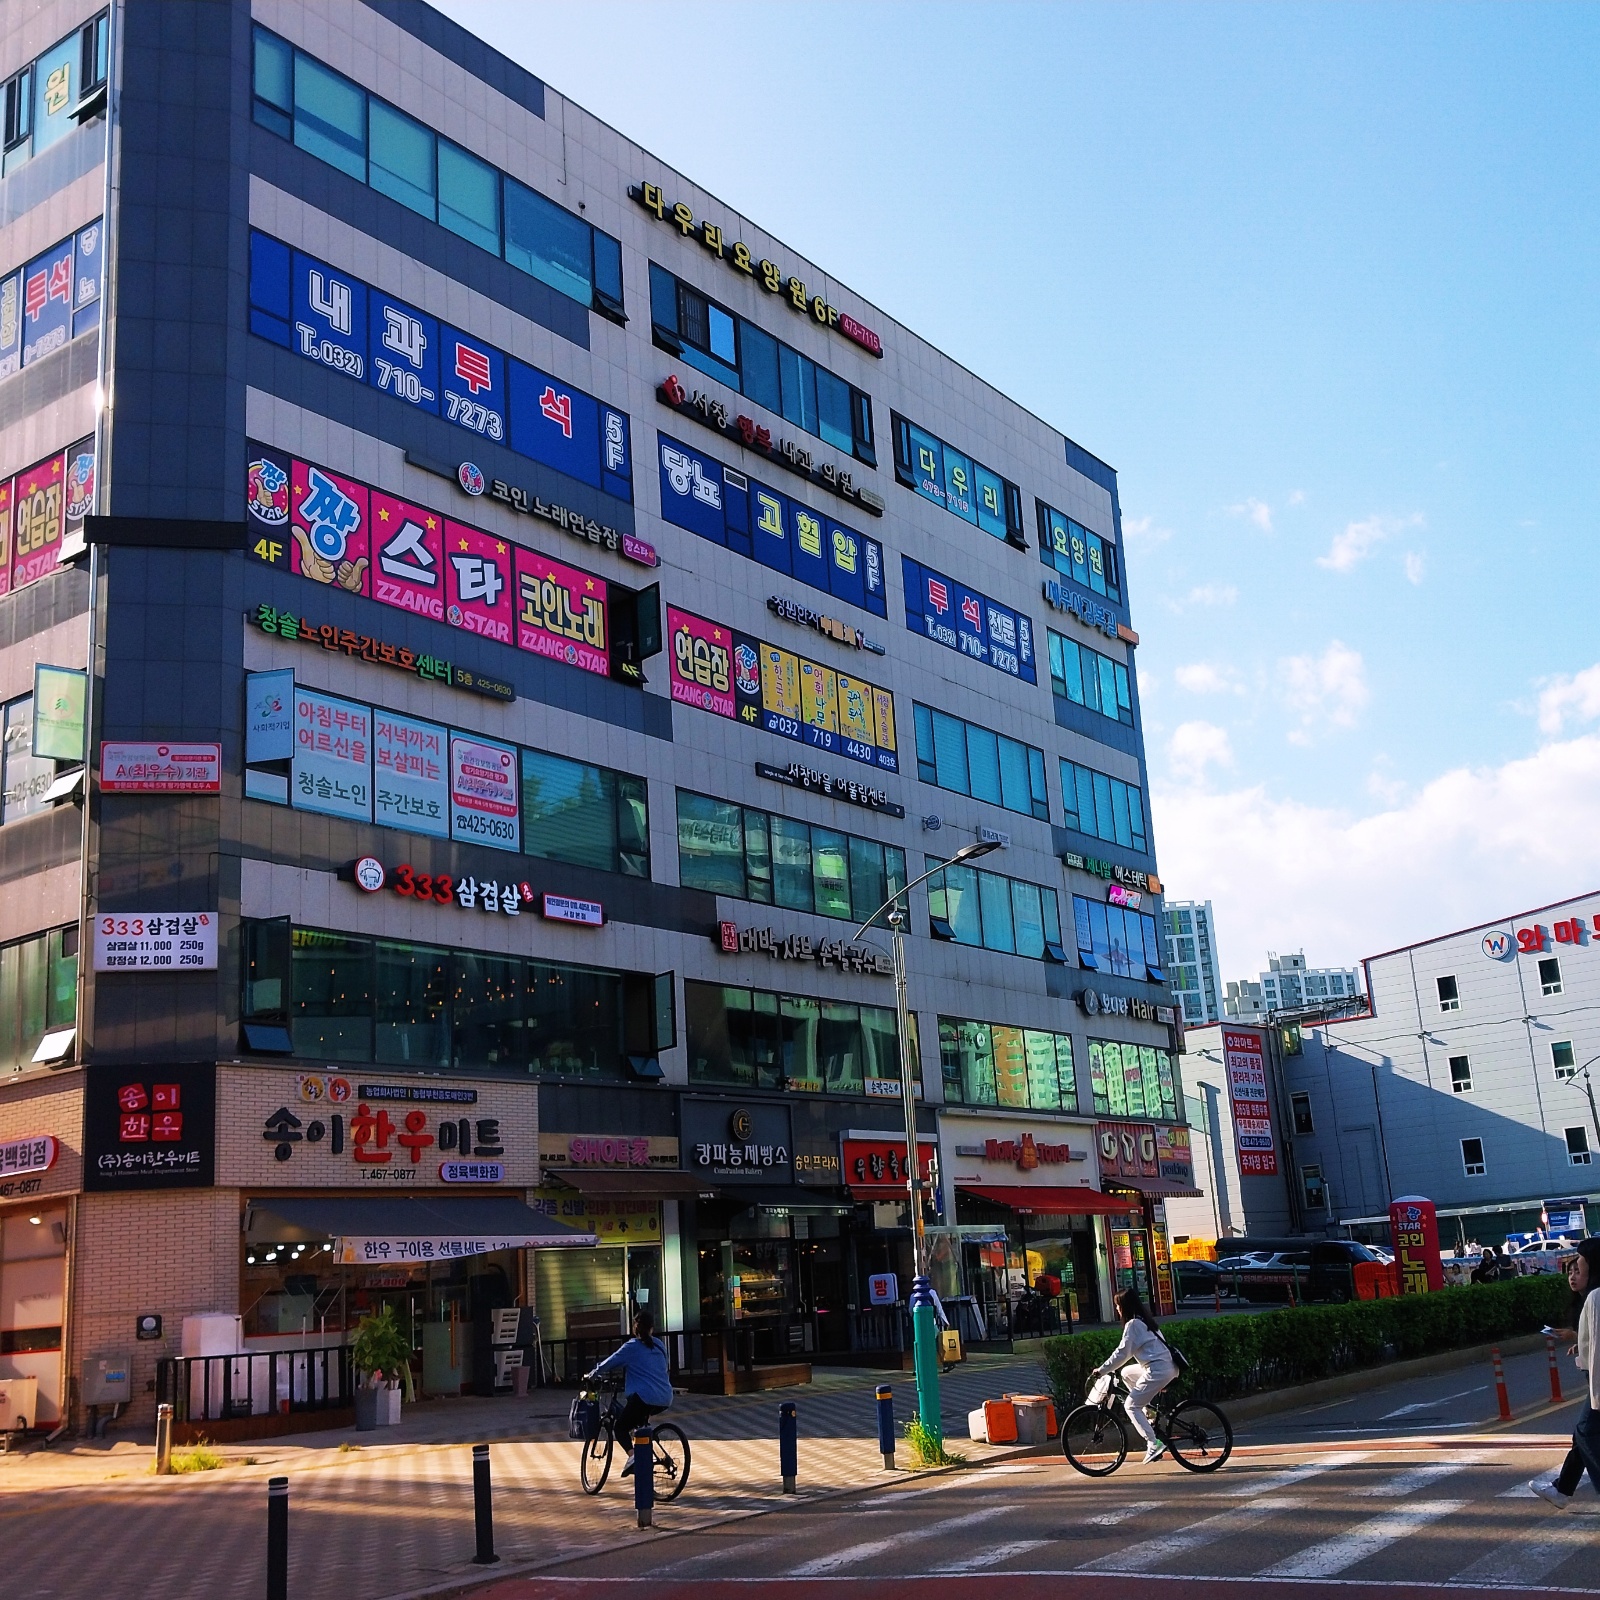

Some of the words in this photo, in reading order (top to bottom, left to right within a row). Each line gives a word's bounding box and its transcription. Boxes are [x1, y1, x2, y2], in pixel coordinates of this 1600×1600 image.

[44, 61, 71, 117] 원
[25, 253, 72, 323] 투석
[844, 315, 880, 350] 473-7115
[444, 389, 505, 442] 7273
[603, 410, 626, 472] 5F
[691, 389, 729, 430] 서창
[779, 437, 815, 474] 내과
[822, 462, 856, 498] 의원
[257, 457, 289, 494] 짱
[919, 446, 999, 517] 다우리
[16, 482, 63, 557] 연습장
[249, 499, 285, 520] STAR
[491, 479, 528, 513] 코인
[532, 496, 619, 551] 노래연습장
[661, 444, 722, 511] 당뇨
[757, 490, 858, 575] 고혈압
[253, 538, 283, 564] 4F
[1053, 526, 1103, 576] 요양원
[375, 579, 444, 620] ZZANG
[462, 612, 509, 643] STAR
[520, 573, 607, 650] 코인노래
[928, 577, 982, 633] 투석
[987, 606, 1017, 650] 전문
[521, 629, 565, 660] ZZANG
[577, 652, 608, 677] STAR
[674, 630, 730, 692] 연습장
[990, 645, 1019, 675] 7273
[457, 669, 474, 687] 5층
[477, 677, 512, 696] 425-0630
[672, 681, 702, 706] ZZANG
[712, 700, 735, 718] STAR
[735, 676, 759, 691] STAR
[298, 700, 367, 738] 아침부터
[376, 721, 440, 756] 저녁까지
[741, 704, 759, 723] 4F
[298, 727, 367, 763] 어르신을
[376, 746, 441, 781] 보살피는
[779, 717, 798, 737] 032
[813, 729, 832, 747] 719
[847, 741, 872, 761] 4430
[185, 766, 208, 779] 기관
[788, 763, 832, 793] 서창마을
[836, 778, 888, 806] 어울림센터
[298, 770, 367, 806] 청솔노인
[376, 788, 442, 820] 주간보호
[467, 814, 515, 840] 425-0630
[394, 863, 454, 905] 333
[456, 875, 522, 916] 삼겹살
[101, 917, 144, 936] 333
[145, 916, 199, 936] 삼겹살
[106, 941, 138, 952] 삼겹살
[140, 940, 172, 951] 11,000
[179, 940, 204, 952] 250g
[139, 955, 172, 966] 12,000
[179, 954, 204, 966] 250g
[738, 926, 779, 959] 대박
[783, 933, 815, 960] 샤브
[819, 937, 876, 974] 손칼국수
[1131, 997, 1154, 1021] Hair
[119, 1087, 177, 1109] 송이
[122, 1115, 180, 1139] 한우
[262, 1102, 505, 1164] 송이한우미트
[97, 1150, 201, 1169] (주)송이한우미트
[360, 1168, 416, 1180] T.467-0877
[447, 1165, 499, 1180] 정육백화점
[1241, 1154, 1262, 1170] 주차장
[1262, 1154, 1276, 1171] 입구
[1397, 1221, 1422, 1231] STAR
[1397, 1232, 1425, 1247] 코인
[363, 1241, 392, 1259] 한우
[395, 1240, 435, 1259] 구이용
[873, 1280, 888, 1297] 빵
[1401, 1249, 1429, 1295] 노래
